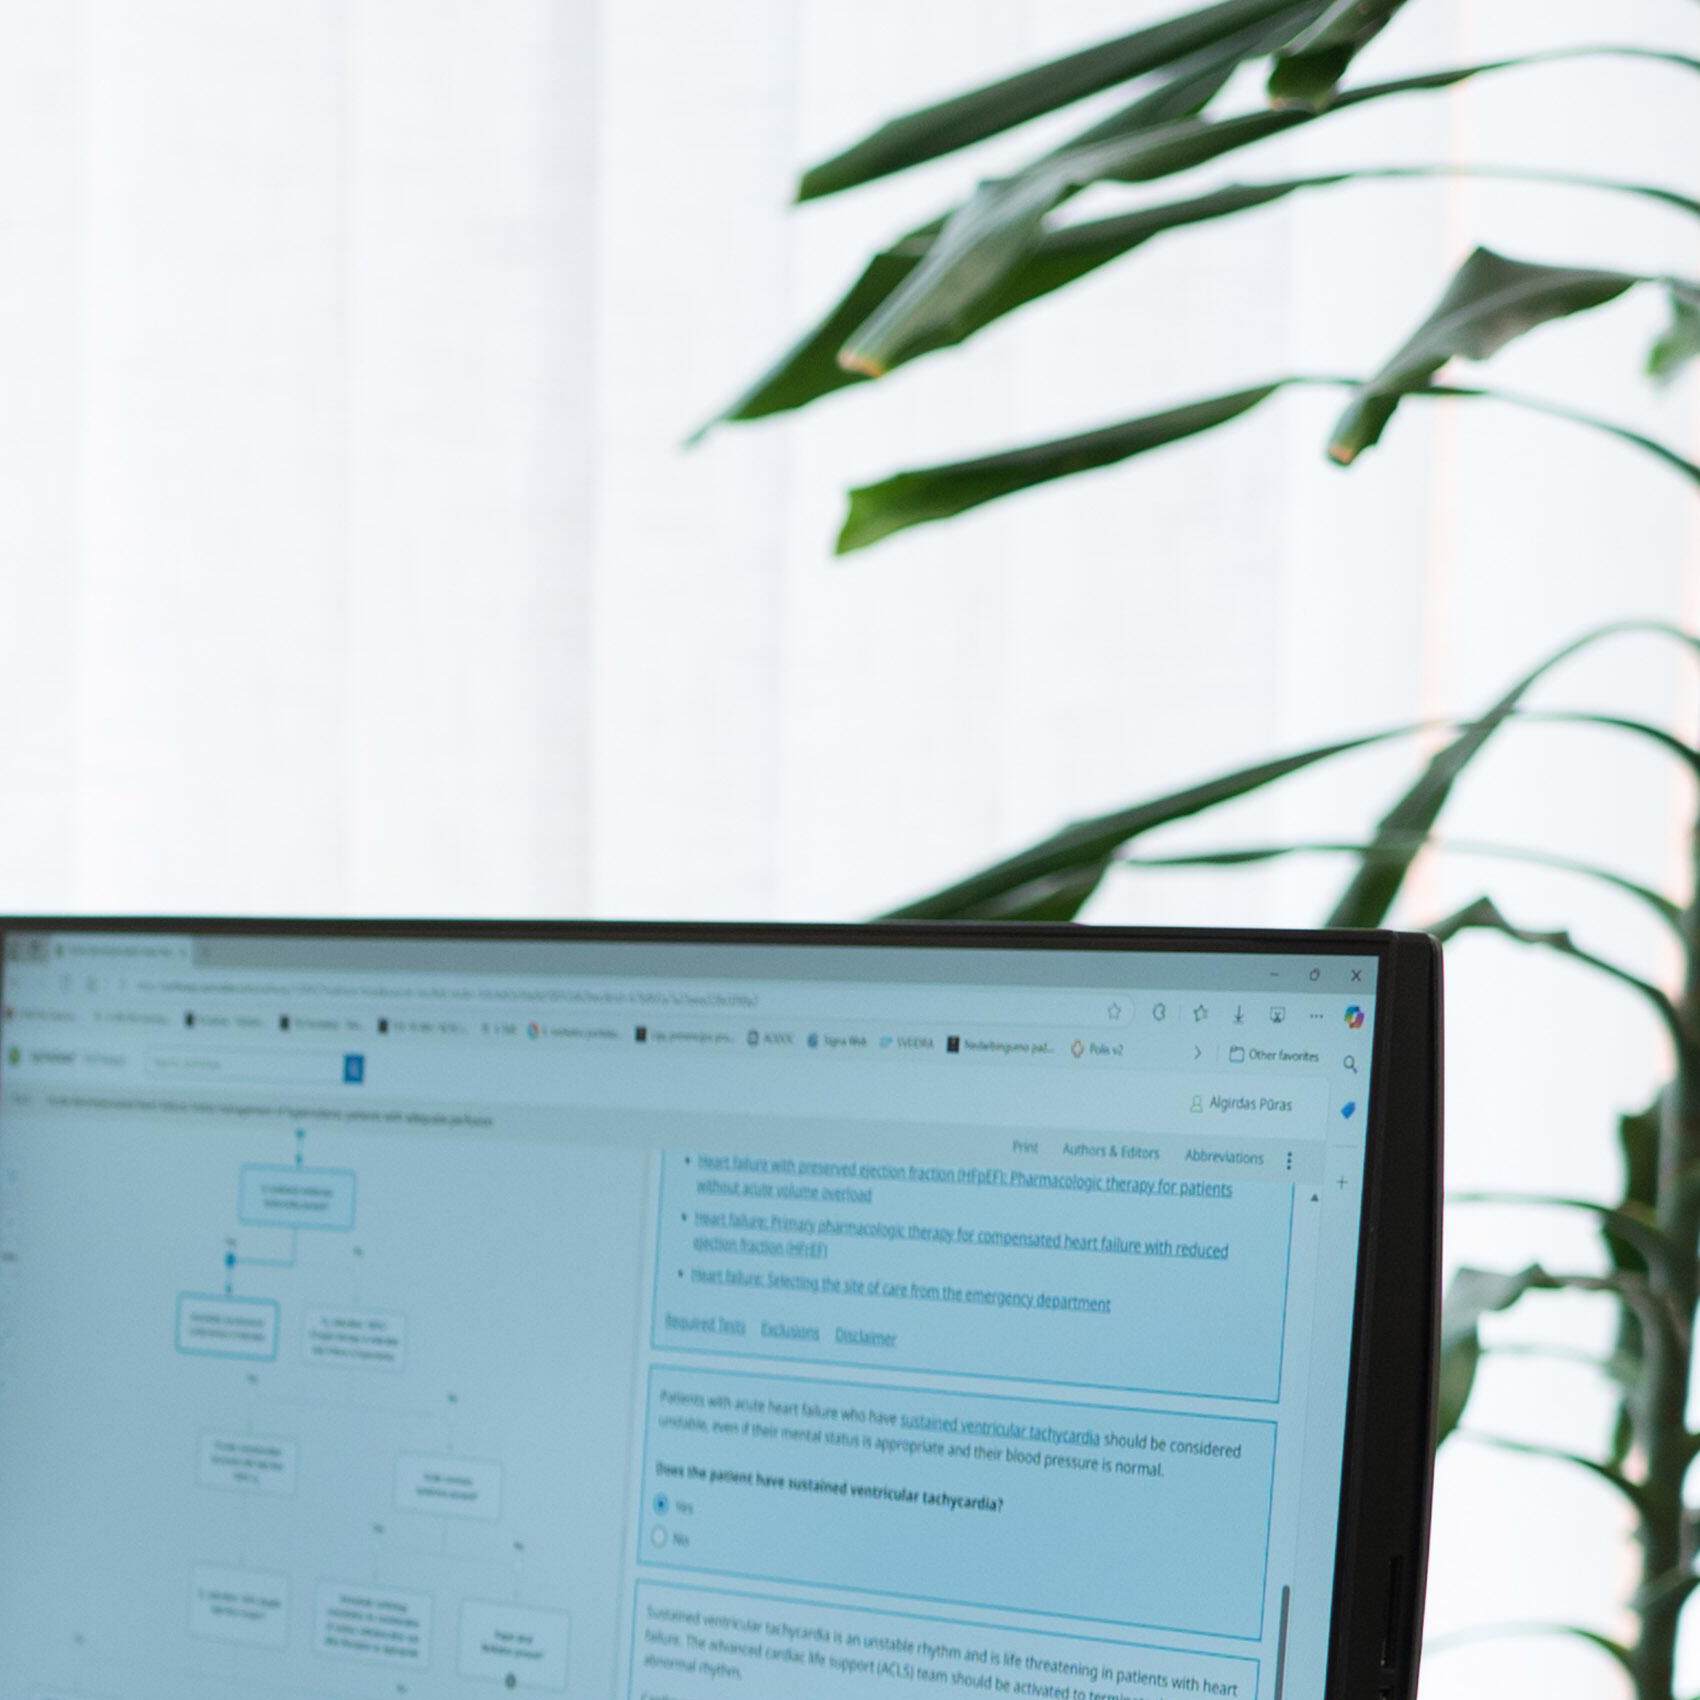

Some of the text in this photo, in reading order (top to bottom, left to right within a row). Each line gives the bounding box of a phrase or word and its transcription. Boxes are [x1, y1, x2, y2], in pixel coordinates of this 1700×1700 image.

[1249, 1049, 1319, 1063] Other favorites
[1210, 1095, 1256, 1112] Algirdas
[1013, 1140, 1039, 1155] Print
[1063, 1143, 1159, 1160] Authors Editors
[1185, 1149, 1264, 1165] Abbreviations
[698, 1154, 1232, 1198] Heart failure with preserved ejection fraction Pharmacologic therapy for patients
[697, 1180, 872, 1203] without acute volume overload
[693, 1237, 783, 1255] ejection fraction
[694, 1211, 1229, 1260] Heart Primary pharmacologic therapy for compensated heart failure with reduced
[691, 1267, 1111, 1314] Heart Selecting the site care from the emergency department
[665, 1313, 715, 1335] Required
[761, 1320, 820, 1341] Exclusions
[835, 1326, 897, 1347] Disclaimer
[660, 1390, 1242, 1458] Patients with acute heart failure who have sustained ventricular tachycardia should considered
[712, 1421, 1165, 1476] even their mental status appropriate and their blood pressure normal.
[656, 1461, 1003, 1511] Does the patient have sustained ventricular tachycardia?
[675, 1500, 693, 1514] Yes
[647, 1605, 1238, 1697] Sustained ventricular tachycardia unstable rhythm and life threatening patients with heart
[644, 1654, 696, 1673] abnormal
[686, 1635, 705, 1651] The
[709, 1639, 762, 1658] advanced
[765, 1647, 805, 1665] cardiac
[809, 1651, 825, 1667] life
[829, 1655, 873, 1676] support
[877, 1660, 913, 1680] (ACLS)
[917, 1668, 947, 1684] team
[951, 1672, 992, 1690] should
[1014, 1680, 1069, 1700] activated
